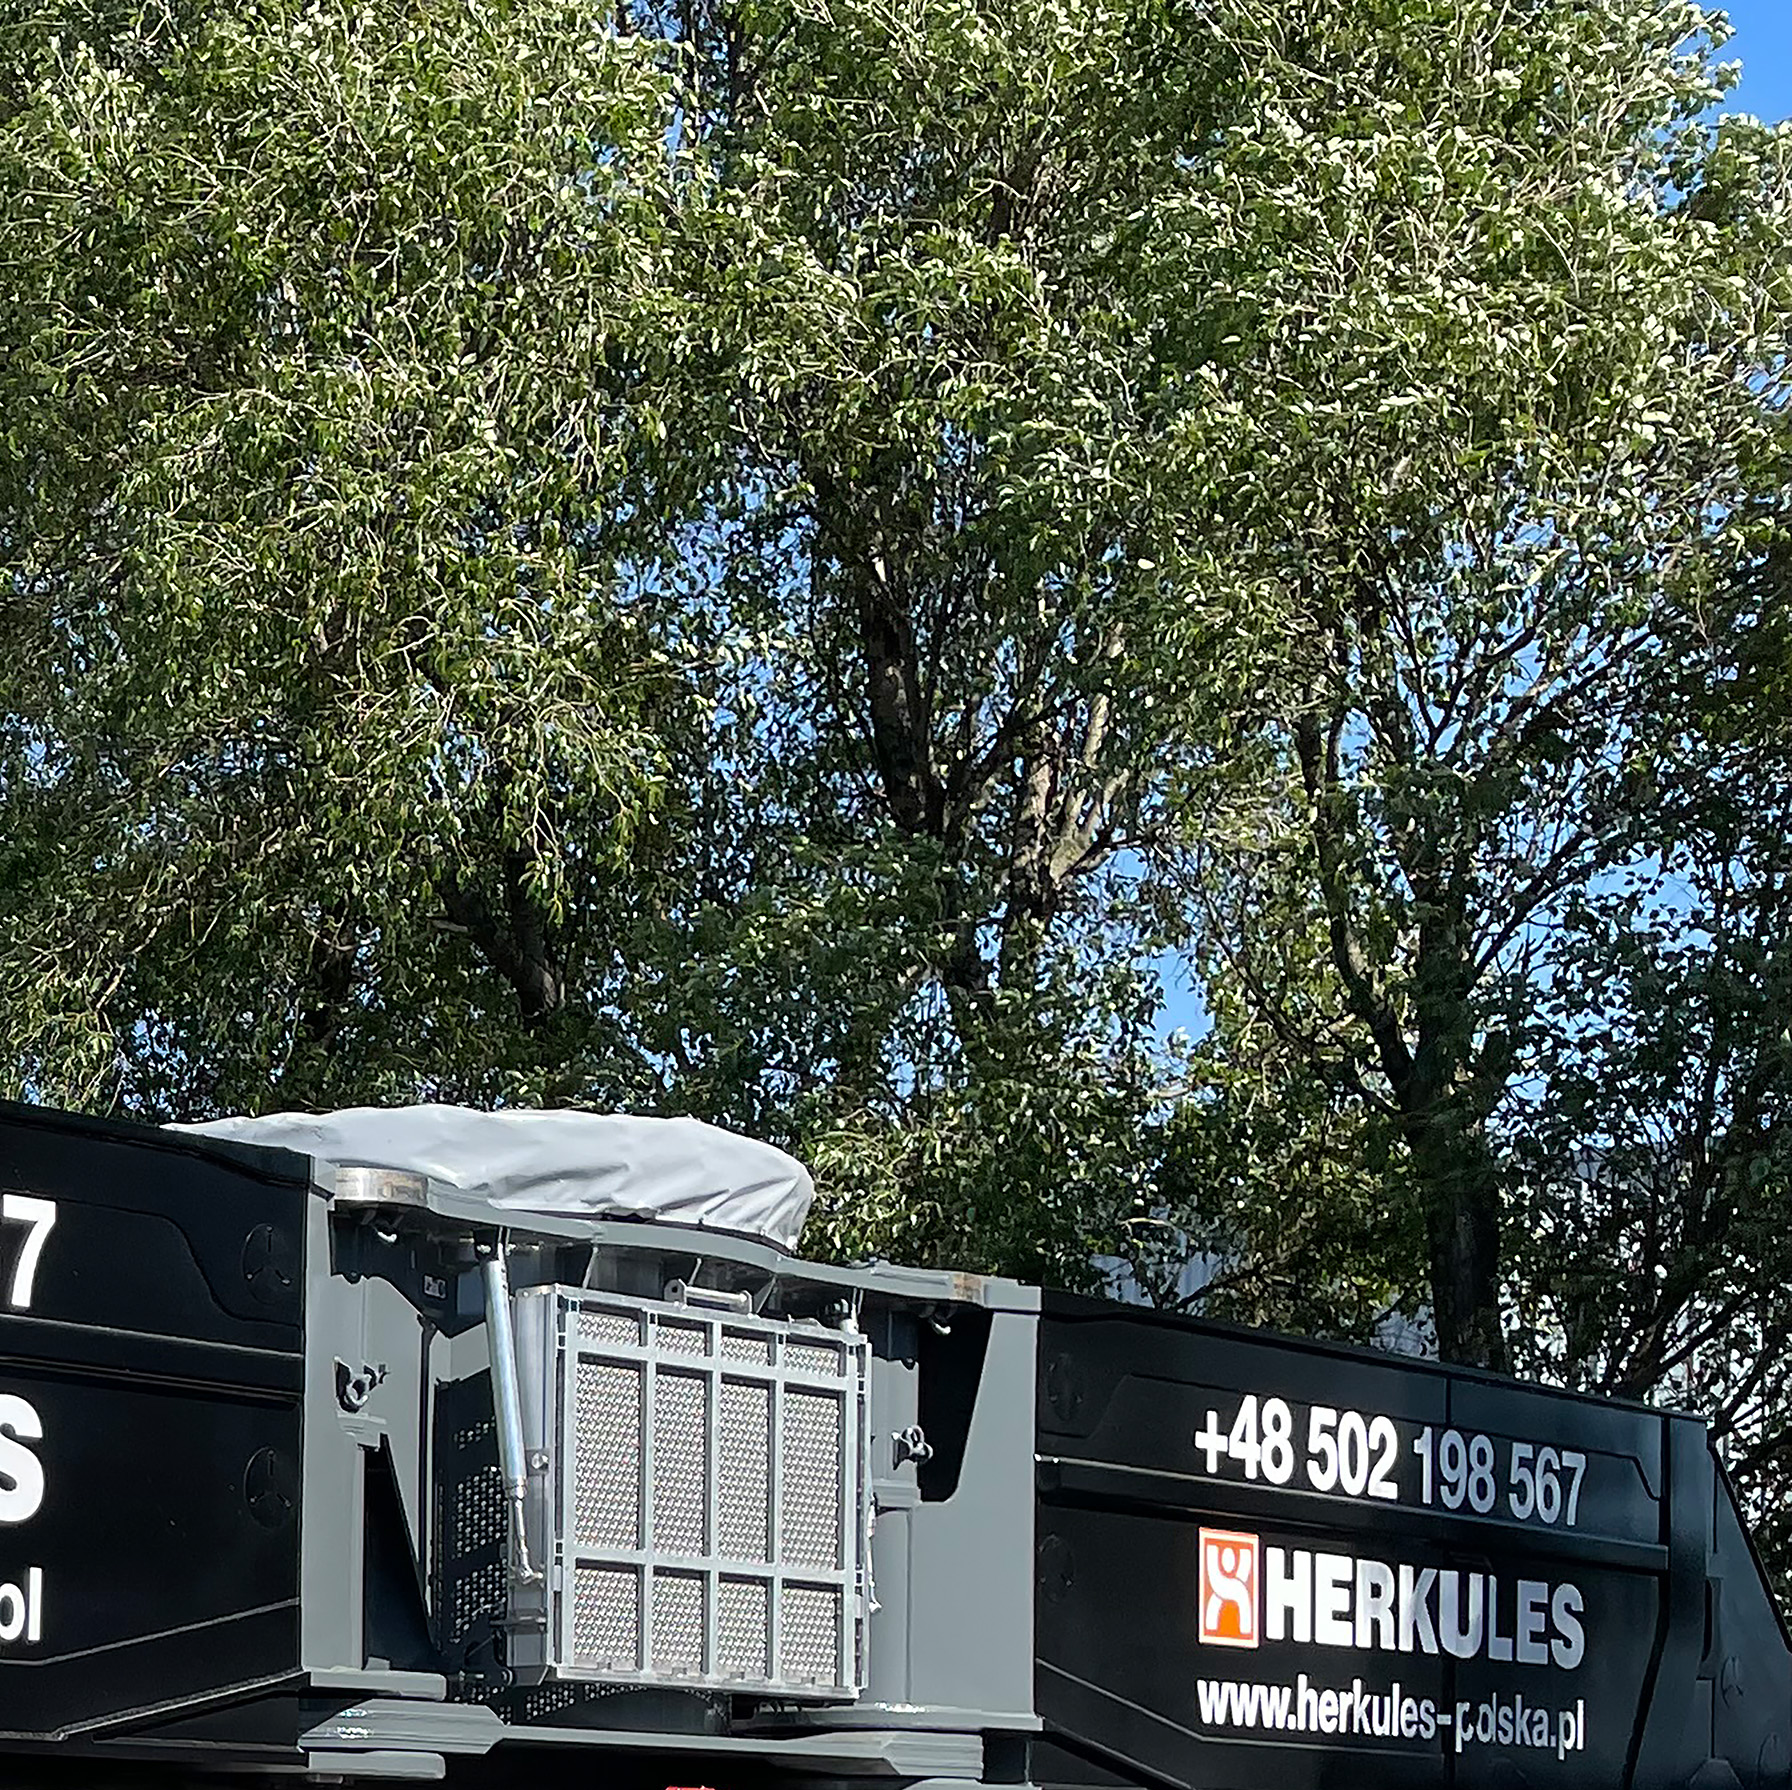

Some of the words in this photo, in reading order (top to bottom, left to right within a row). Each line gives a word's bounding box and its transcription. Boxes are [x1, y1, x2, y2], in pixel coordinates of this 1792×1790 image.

[1194, 1393, 1295, 1487] +48
[1305, 1405, 1400, 1501] 502
[1412, 1425, 1497, 1514] 198
[1507, 1441, 1587, 1527] 567
[1264, 1545, 1586, 1671] HERKULES
[1196, 1672, 1586, 1762] www.herkules-polska.pl
